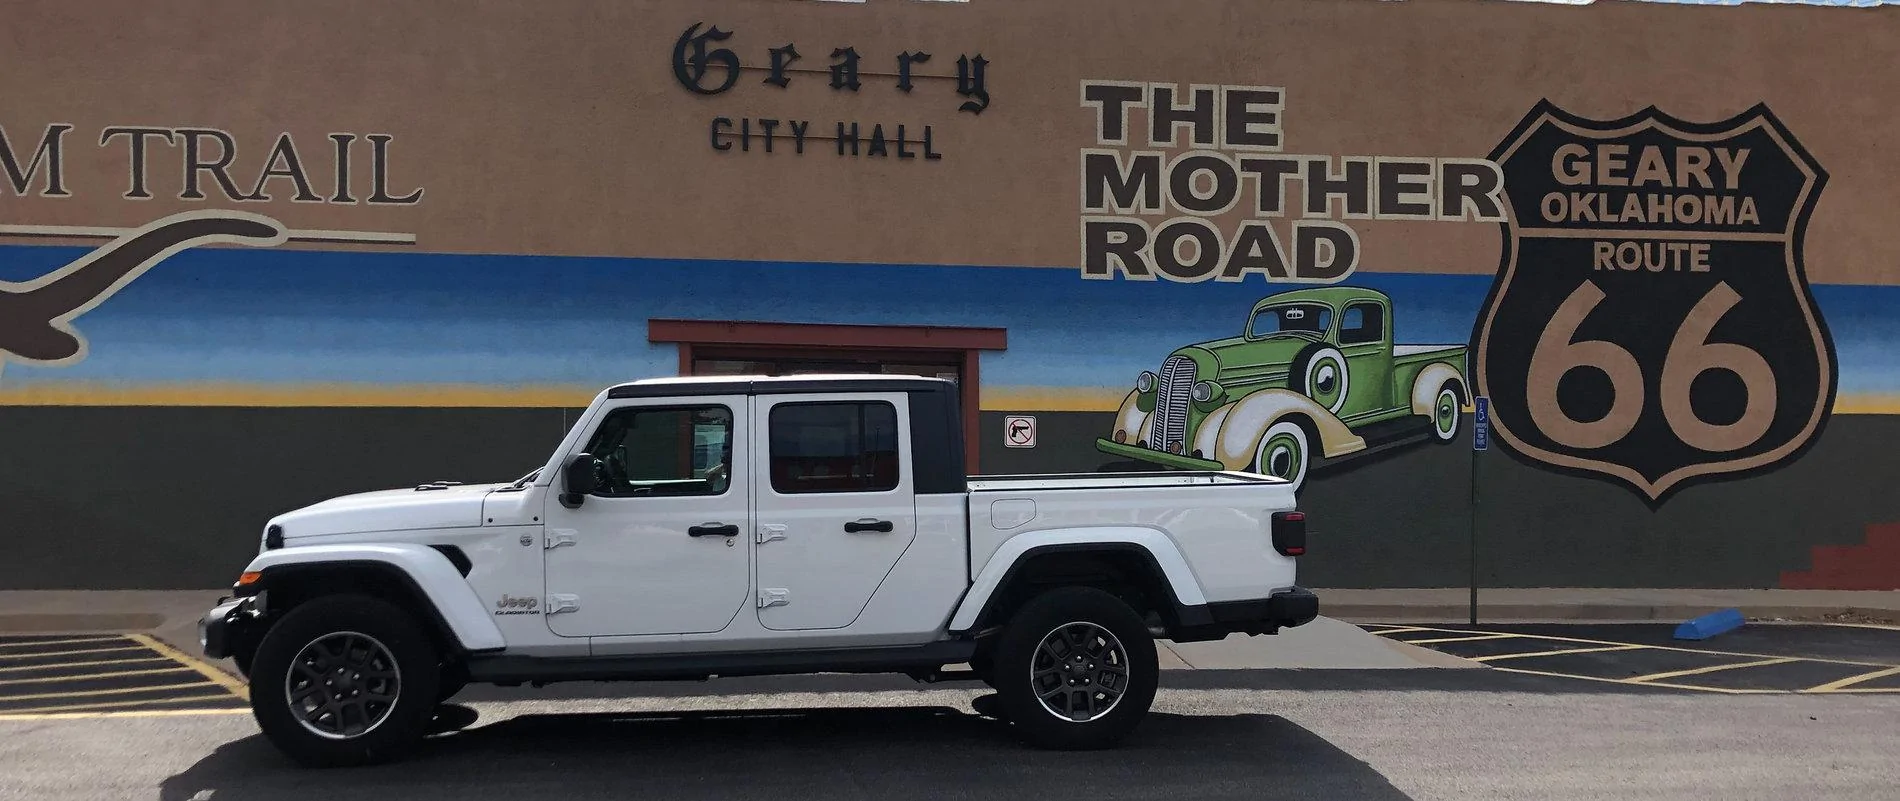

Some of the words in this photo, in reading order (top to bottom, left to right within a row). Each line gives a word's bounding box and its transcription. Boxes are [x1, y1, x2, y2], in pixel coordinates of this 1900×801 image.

[673, 21, 990, 115] Geary
[711, 117, 808, 154] CITY
[837, 120, 942, 159] HALL
[1080, 79, 1286, 151] THE
[99, 125, 425, 205] TRAIL
[1080, 148, 1508, 223] MOTHER
[1551, 143, 1751, 189] GEARY
[1540, 191, 1761, 225] OKLAHOMA
[1080, 215, 1361, 284] ROAD
[1593, 241, 1712, 272] ROUTE
[1526, 279, 1778, 452] 66
[496, 593, 538, 610] Jeep
